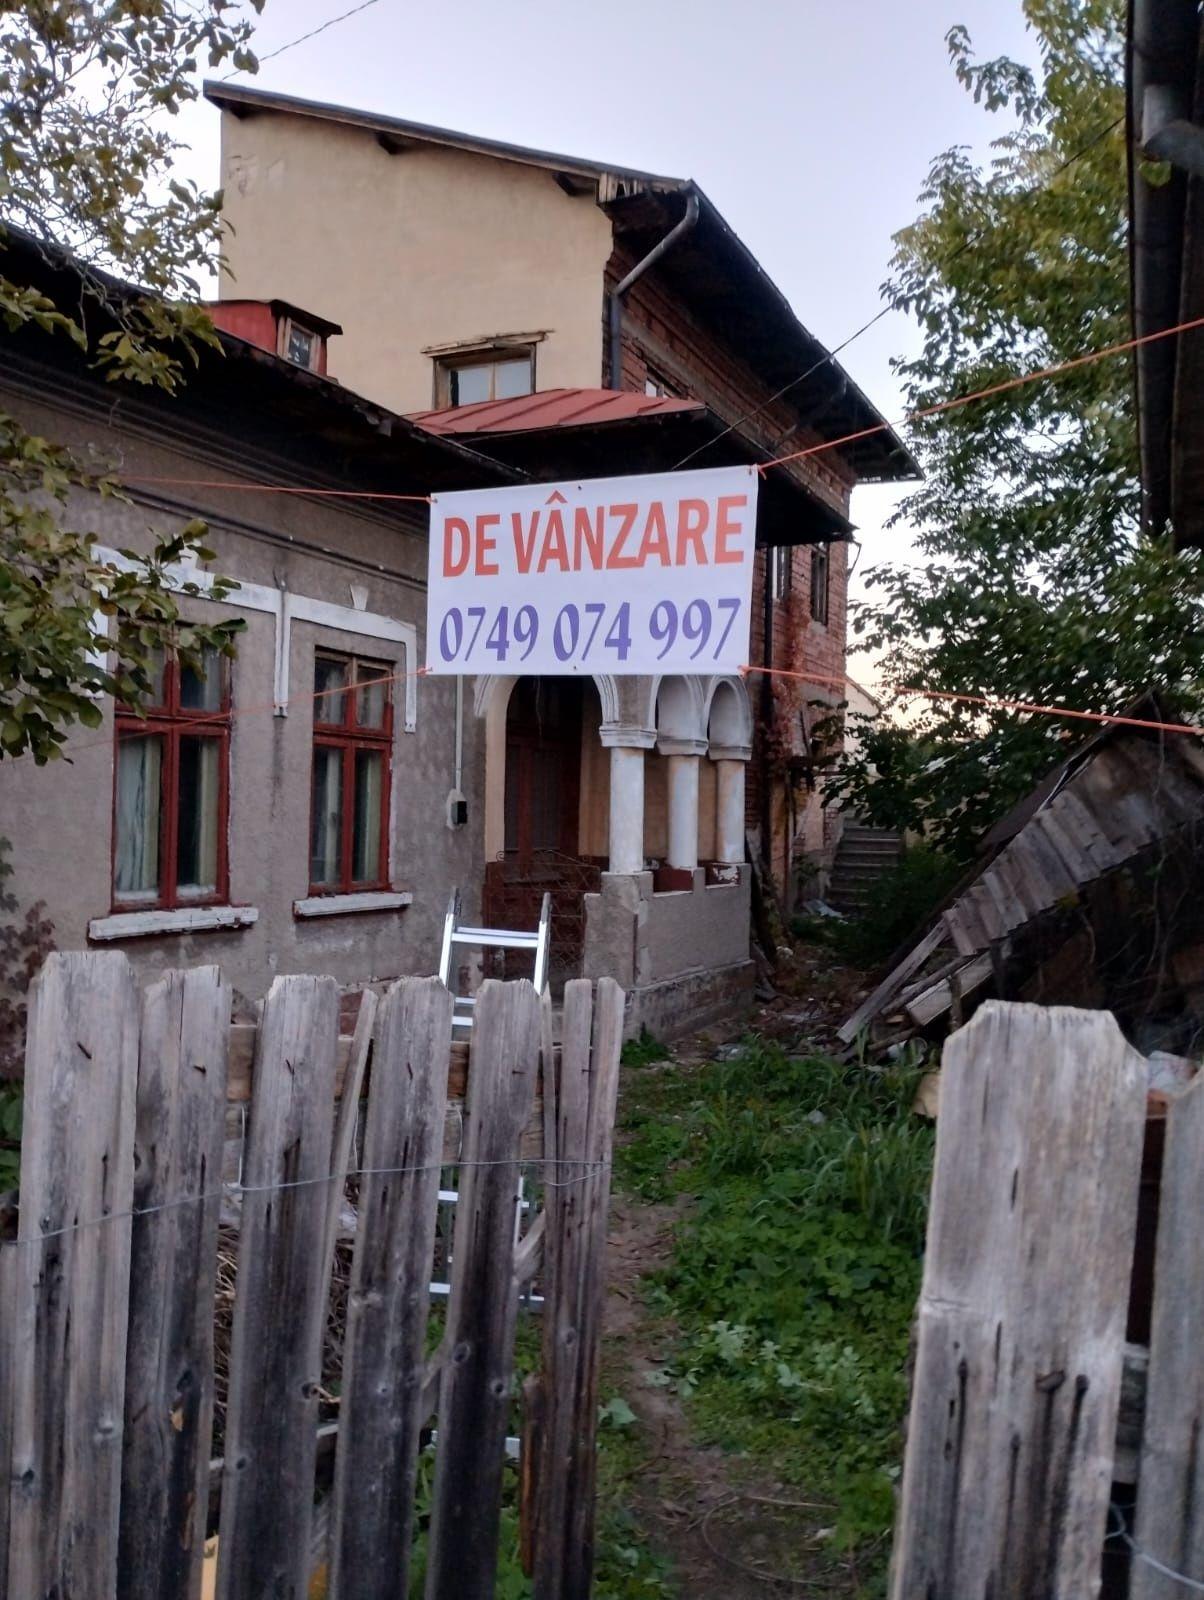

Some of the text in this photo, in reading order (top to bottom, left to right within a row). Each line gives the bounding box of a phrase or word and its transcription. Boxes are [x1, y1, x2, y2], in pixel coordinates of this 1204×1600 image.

[442, 489, 748, 577] DE VÂNZARE
[439, 597, 742, 662] 0749 074 997
